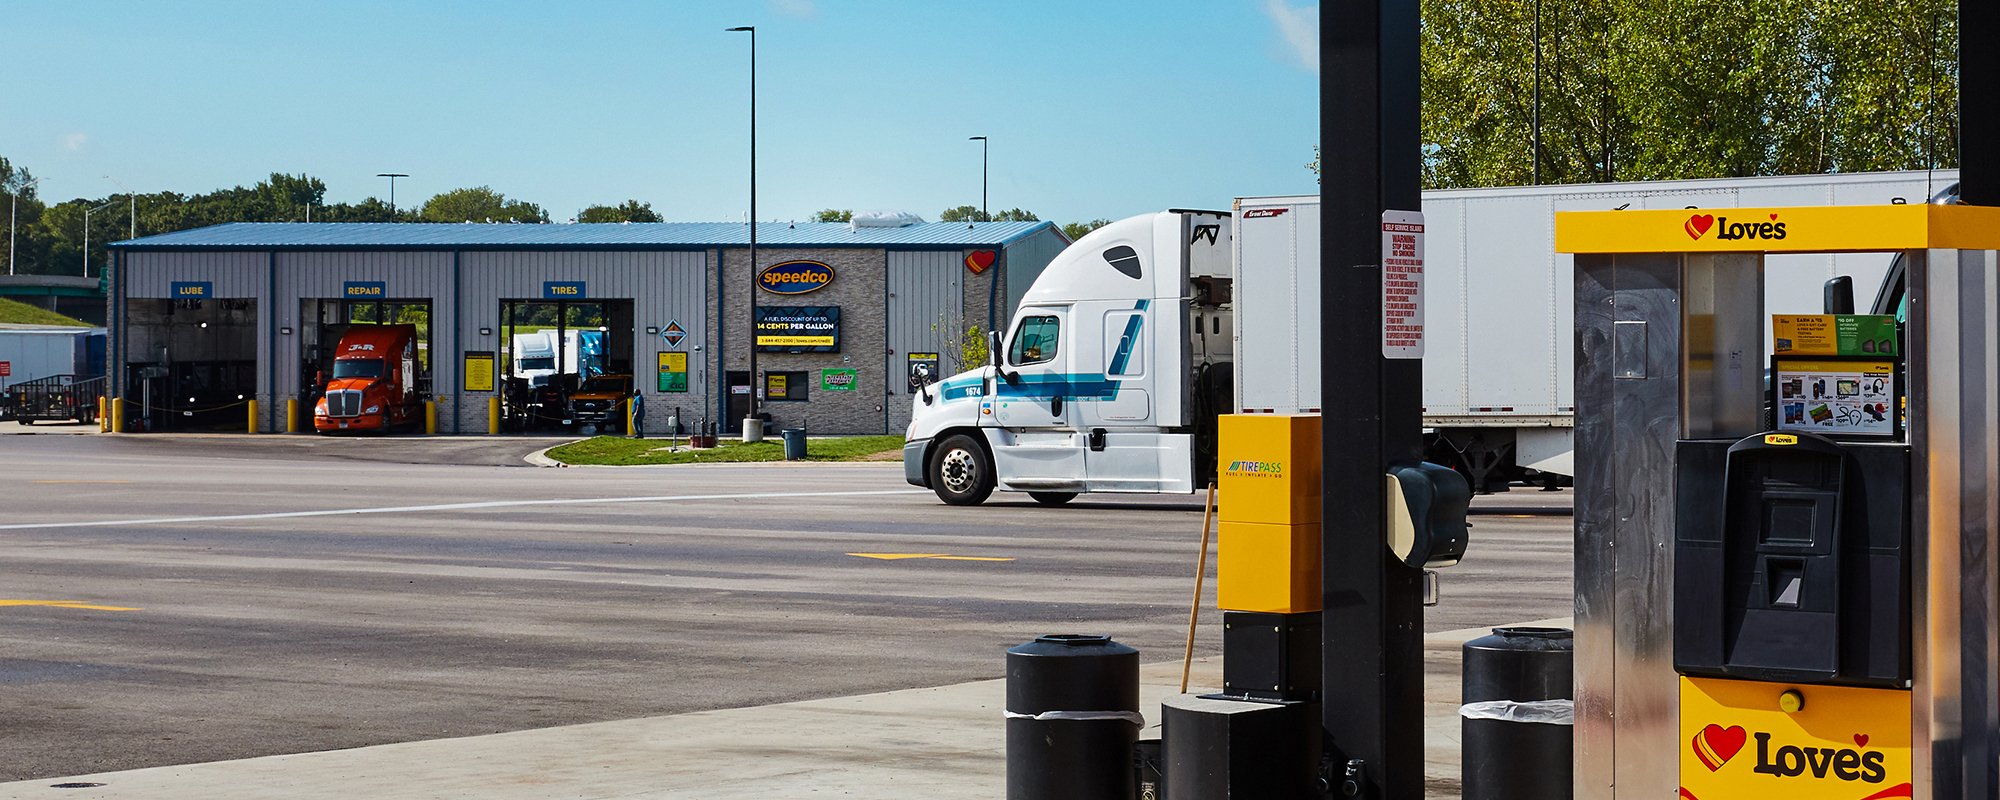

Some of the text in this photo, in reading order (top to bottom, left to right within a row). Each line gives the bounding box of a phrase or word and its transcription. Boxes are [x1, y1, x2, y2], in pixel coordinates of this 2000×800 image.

[1392, 235, 1415, 243] WARNING
[763, 270, 828, 285] speedco
[179, 286, 203, 295] LUBE
[347, 286, 381, 295] REPAIR
[551, 286, 578, 295] TIRES
[965, 387, 981, 396] 1674
[1241, 461, 1281, 472] TIREPASS
